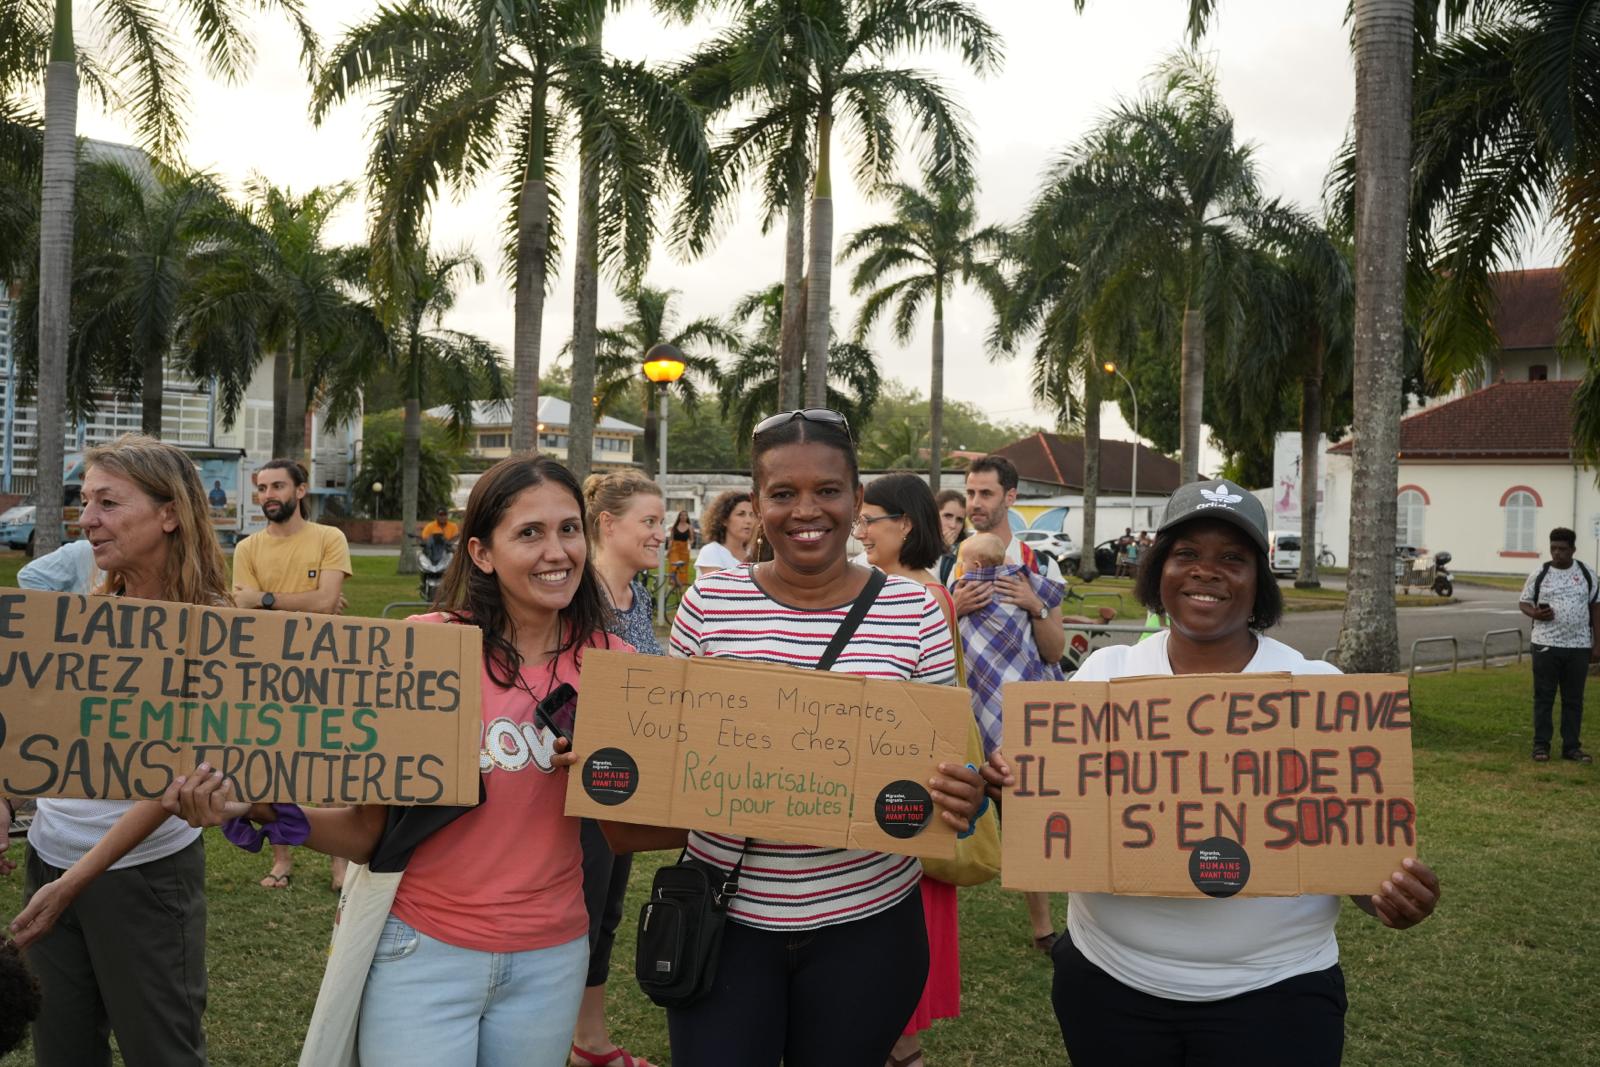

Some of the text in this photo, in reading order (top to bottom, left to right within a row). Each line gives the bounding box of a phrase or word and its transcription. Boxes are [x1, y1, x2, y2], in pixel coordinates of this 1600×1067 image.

[201, 610, 256, 658] DE
[161, 657, 228, 699] LES
[236, 661, 460, 712] FRONTIÈRES
[620, 668, 902, 735] Femmes Migrantes,
[80, 694, 379, 752] FÉMINISTES
[627, 710, 688, 743] Vous
[717, 718, 772, 750] Etes
[791, 729, 851, 766] Chez
[1024, 698, 1171, 747] FEMME
[1187, 689, 1311, 735] C'EST
[3, 734, 444, 803] SANS FRONTIÈRES
[591, 780, 630, 789] AVANT TOUT
[592, 771, 630, 780] HUMAINS
[683, 750, 848, 817] Régularisation
[1013, 754, 1061, 797] IL
[1077, 749, 1189, 797] FAUT
[729, 798, 775, 827] pour
[885, 804, 925, 812] HUMAINS
[885, 813, 924, 821] AVANT TOUT
[1044, 796, 1417, 859] A S'EN SORTIR
[1199, 871, 1240, 879] AVANT TOUT
[1200, 862, 1241, 871] HUMAINS
